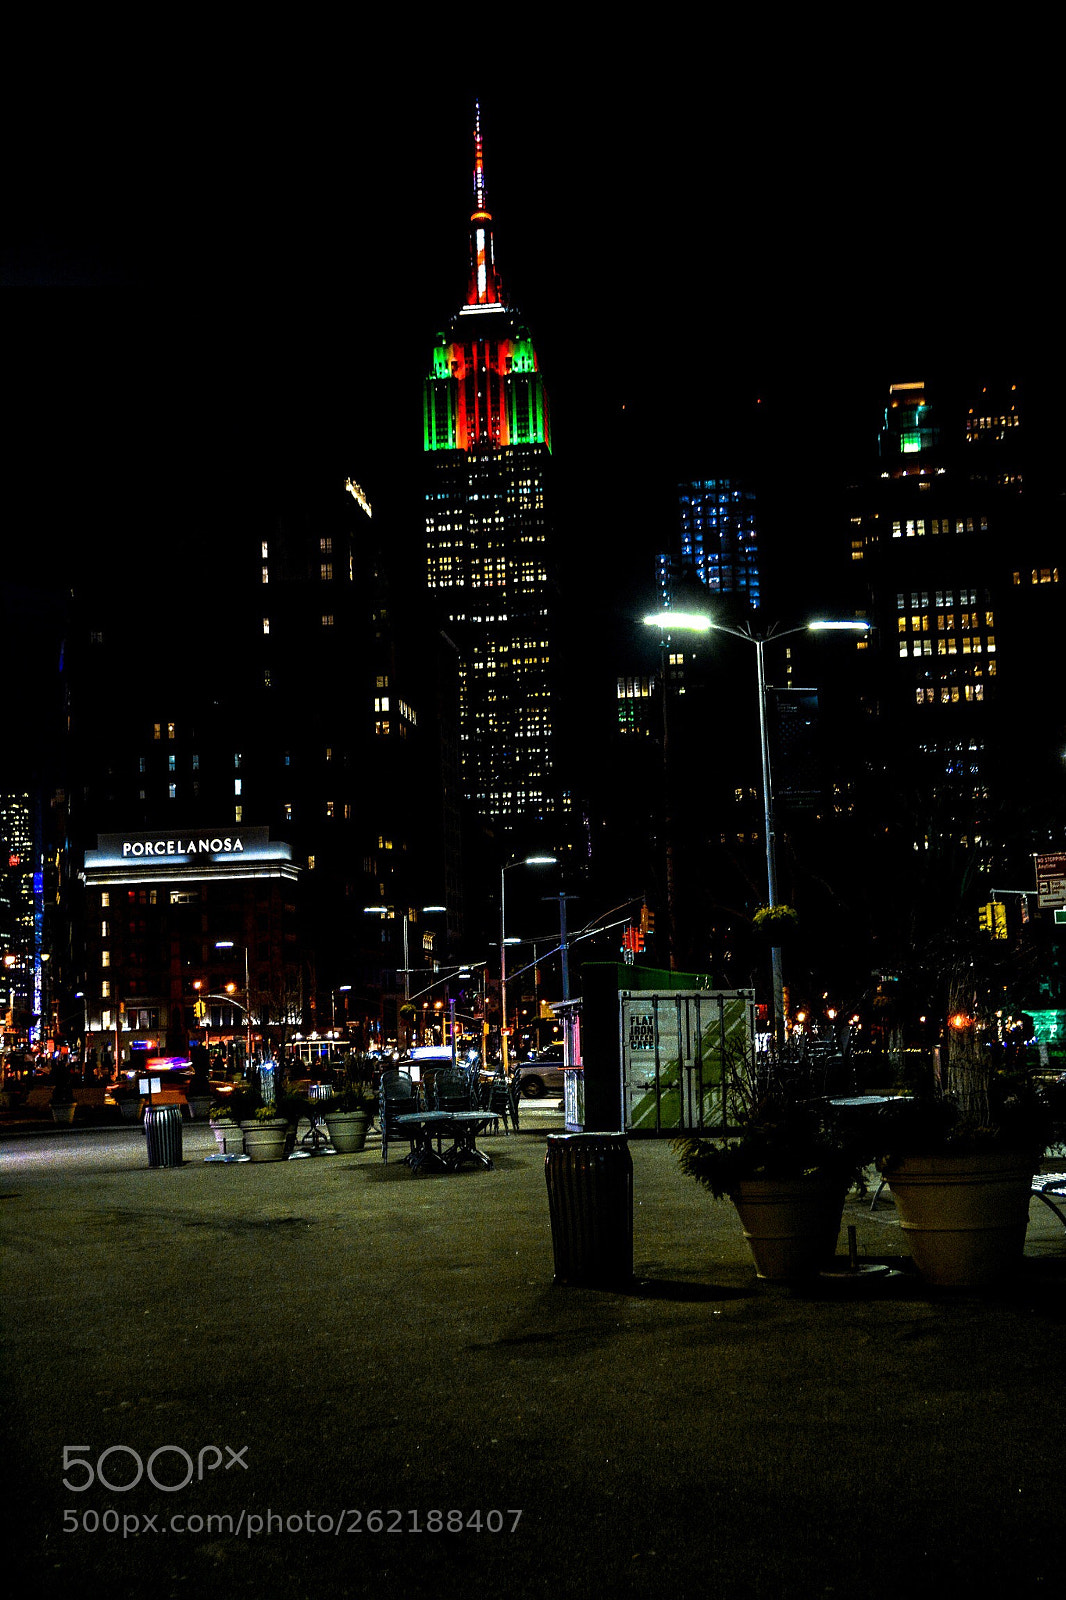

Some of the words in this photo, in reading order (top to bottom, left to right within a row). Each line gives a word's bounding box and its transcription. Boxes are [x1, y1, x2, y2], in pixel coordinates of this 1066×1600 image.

[123, 838, 243, 856] PORCELANOSA
[630, 1015, 653, 1026] FLAT
[630, 1025, 653, 1035] IRON
[630, 1040, 654, 1050] CAFE
